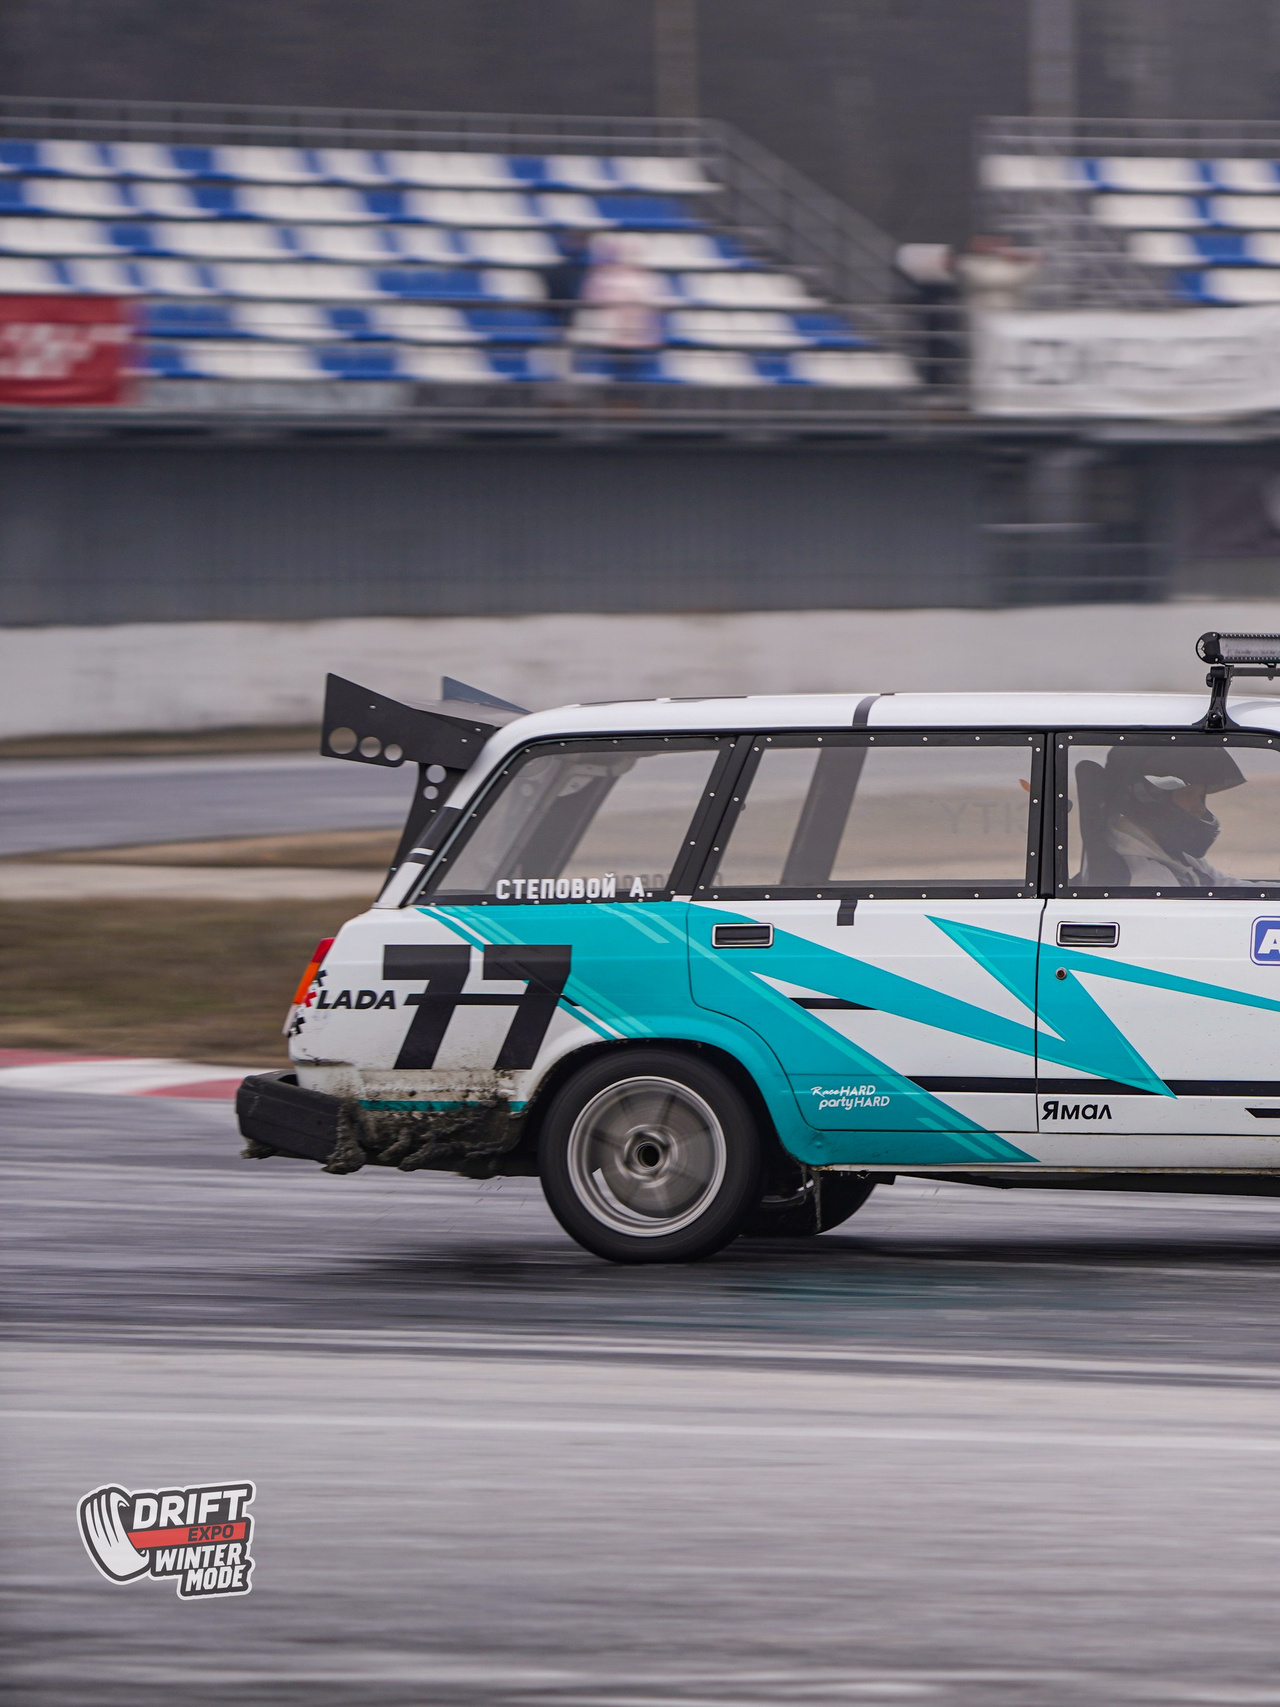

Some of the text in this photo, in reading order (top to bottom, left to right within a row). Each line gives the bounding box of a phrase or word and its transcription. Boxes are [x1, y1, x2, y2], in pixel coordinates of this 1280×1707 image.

[496, 872, 616, 899] СТЕПОВОЙ
[629, 877, 653, 898] А.
[316, 989, 396, 1010] LADA
[382, 944, 573, 1070] 77
[1041, 1100, 1113, 1120] Ямал
